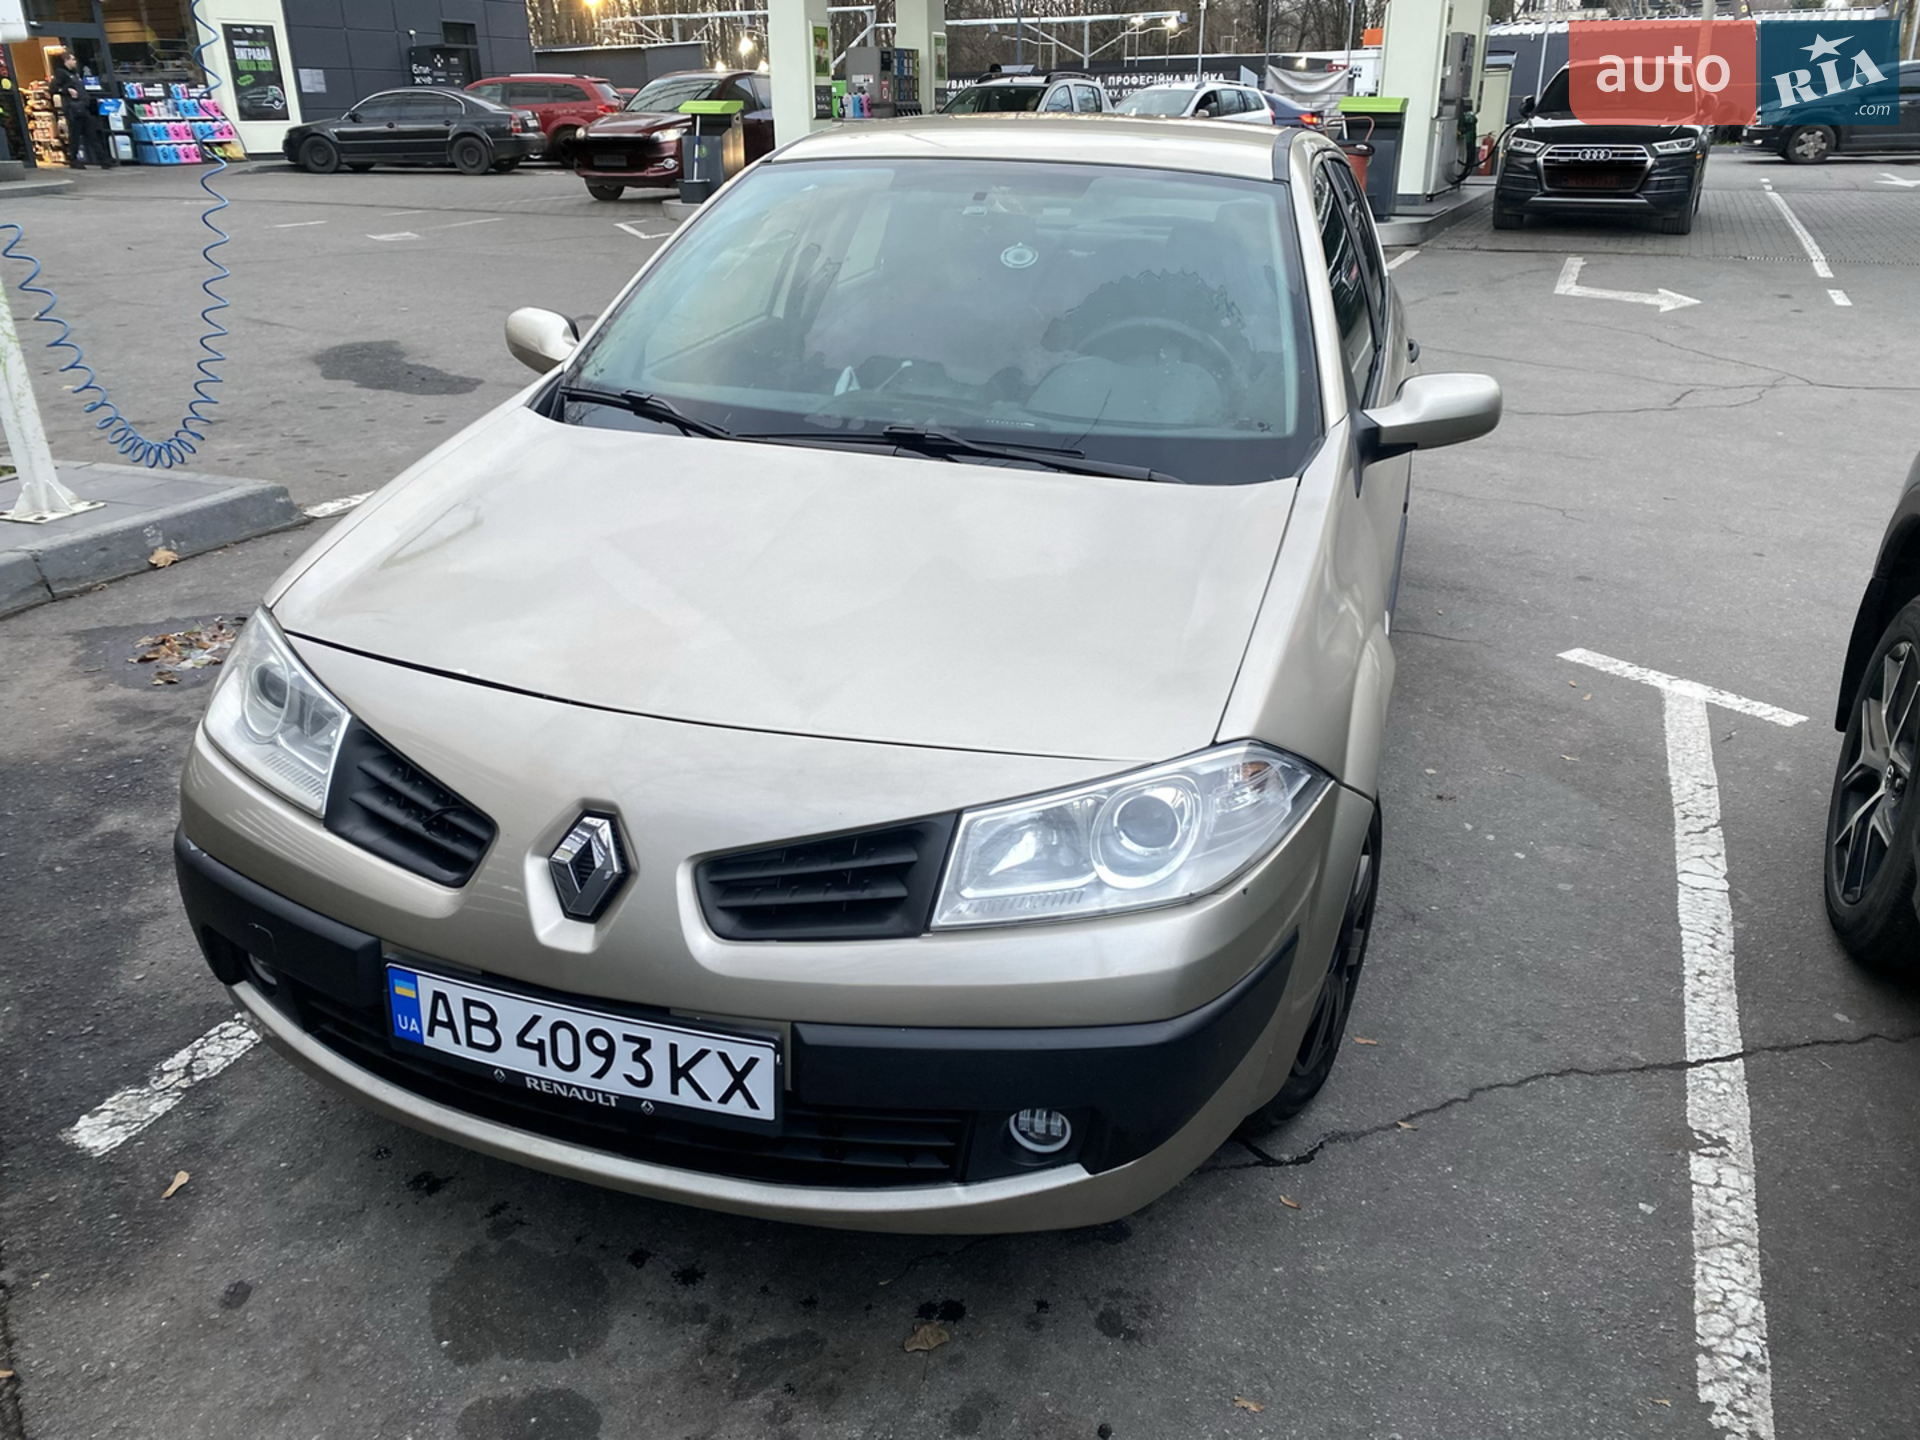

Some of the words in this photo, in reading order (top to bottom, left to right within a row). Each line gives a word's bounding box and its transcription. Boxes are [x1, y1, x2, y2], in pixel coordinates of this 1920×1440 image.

[397, 1013, 420, 1034] UA
[427, 989, 502, 1054] AB
[516, 1013, 654, 1089] 4093
[668, 1041, 761, 1111] KX
[524, 1075, 620, 1108] RENAULT
